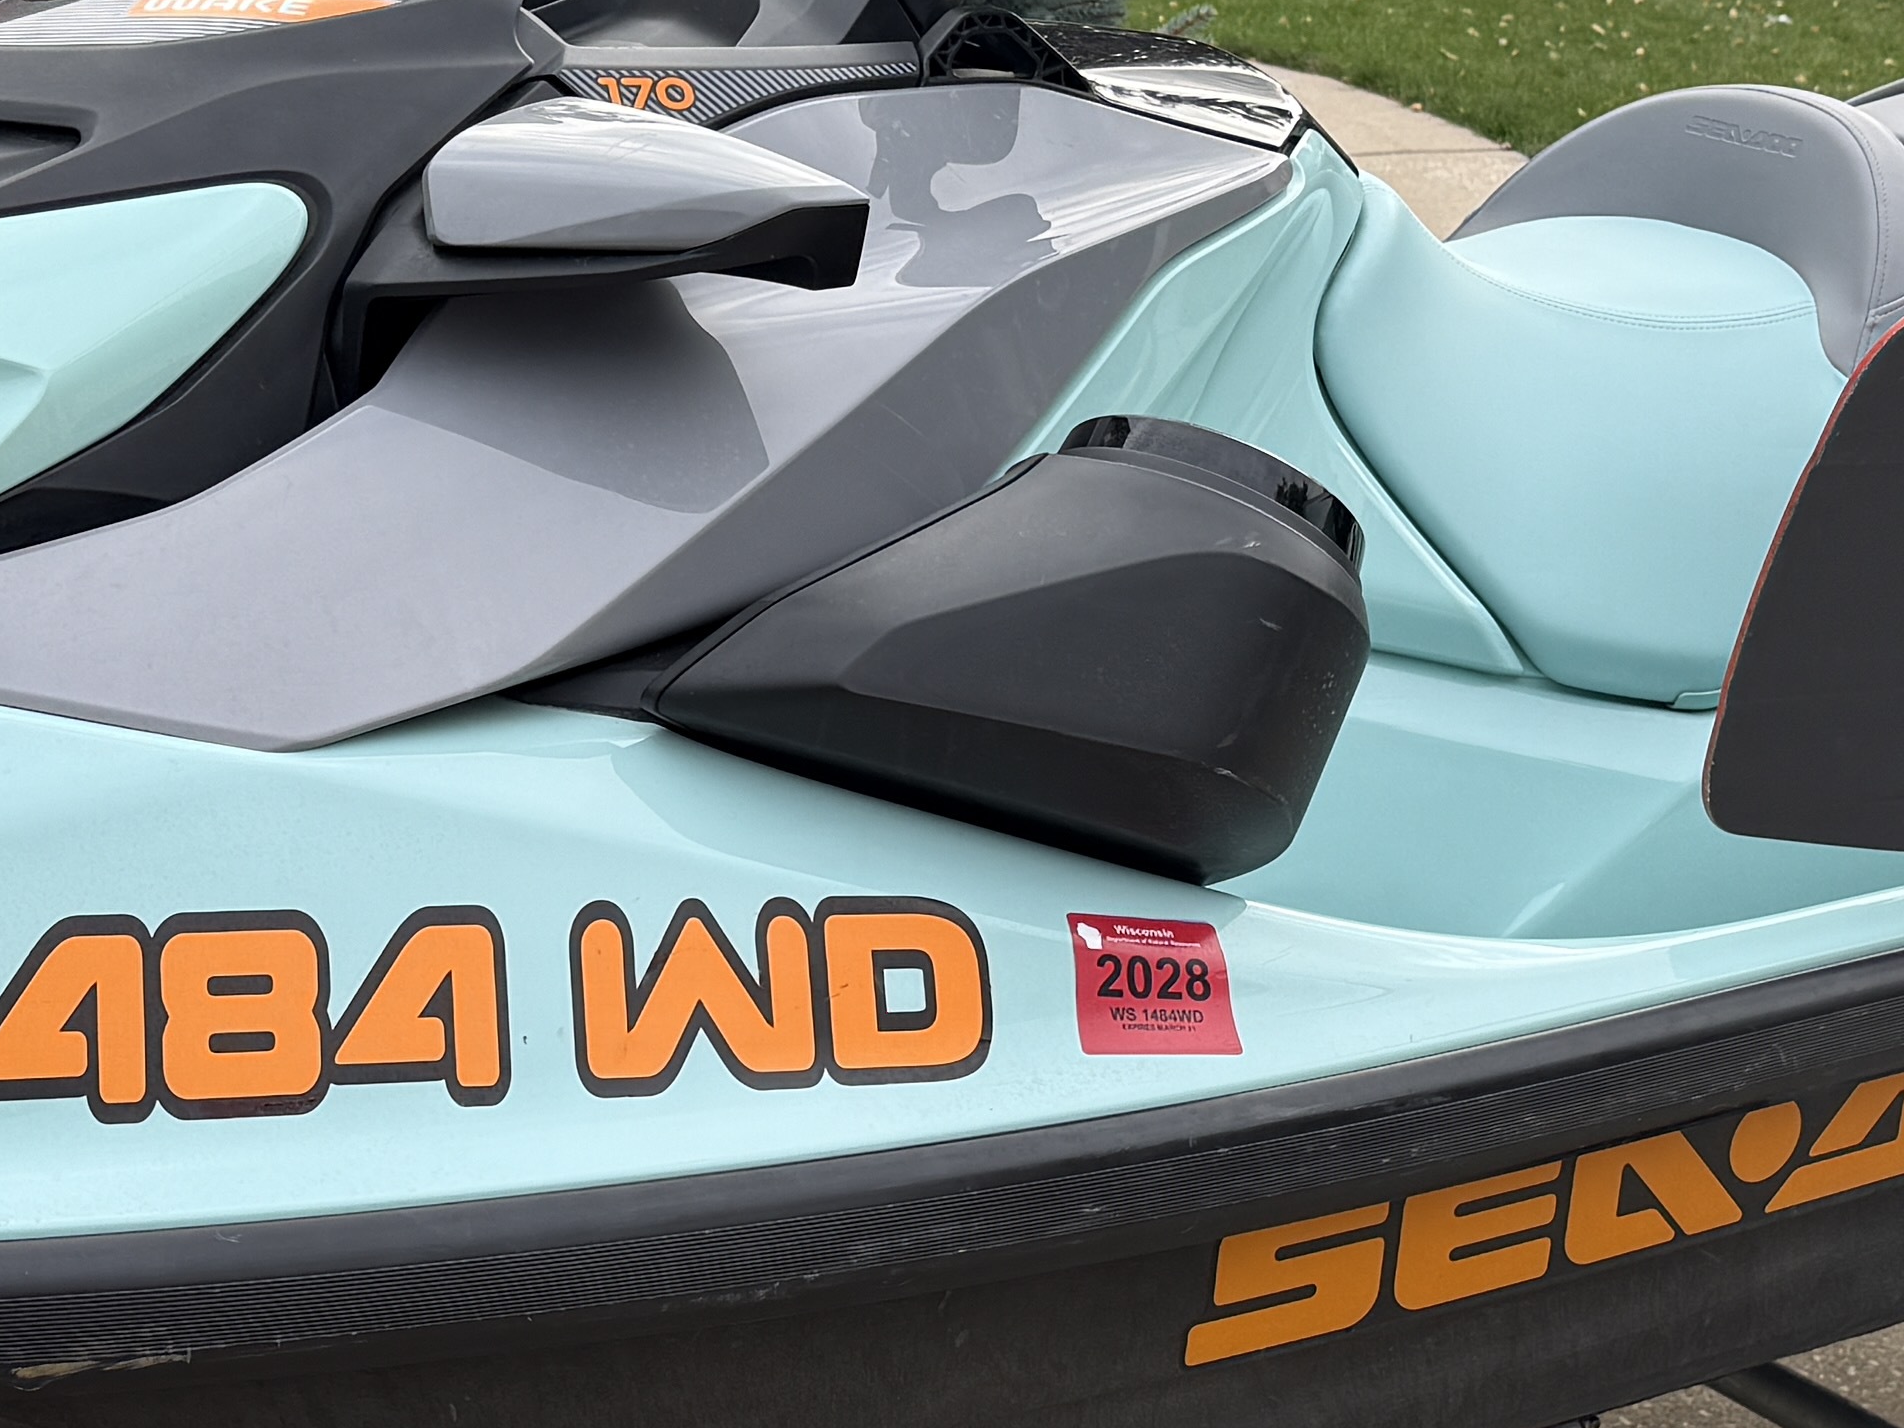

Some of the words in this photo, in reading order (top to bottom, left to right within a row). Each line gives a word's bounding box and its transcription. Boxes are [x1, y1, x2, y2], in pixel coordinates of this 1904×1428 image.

[596, 75, 696, 112] 170
[1113, 924, 1175, 939] Wisconsin
[572, 902, 994, 1090] WD
[1096, 953, 1212, 1002] 2028
[1109, 1006, 1137, 1022] WS
[1142, 1008, 1205, 1024] 1484WD
